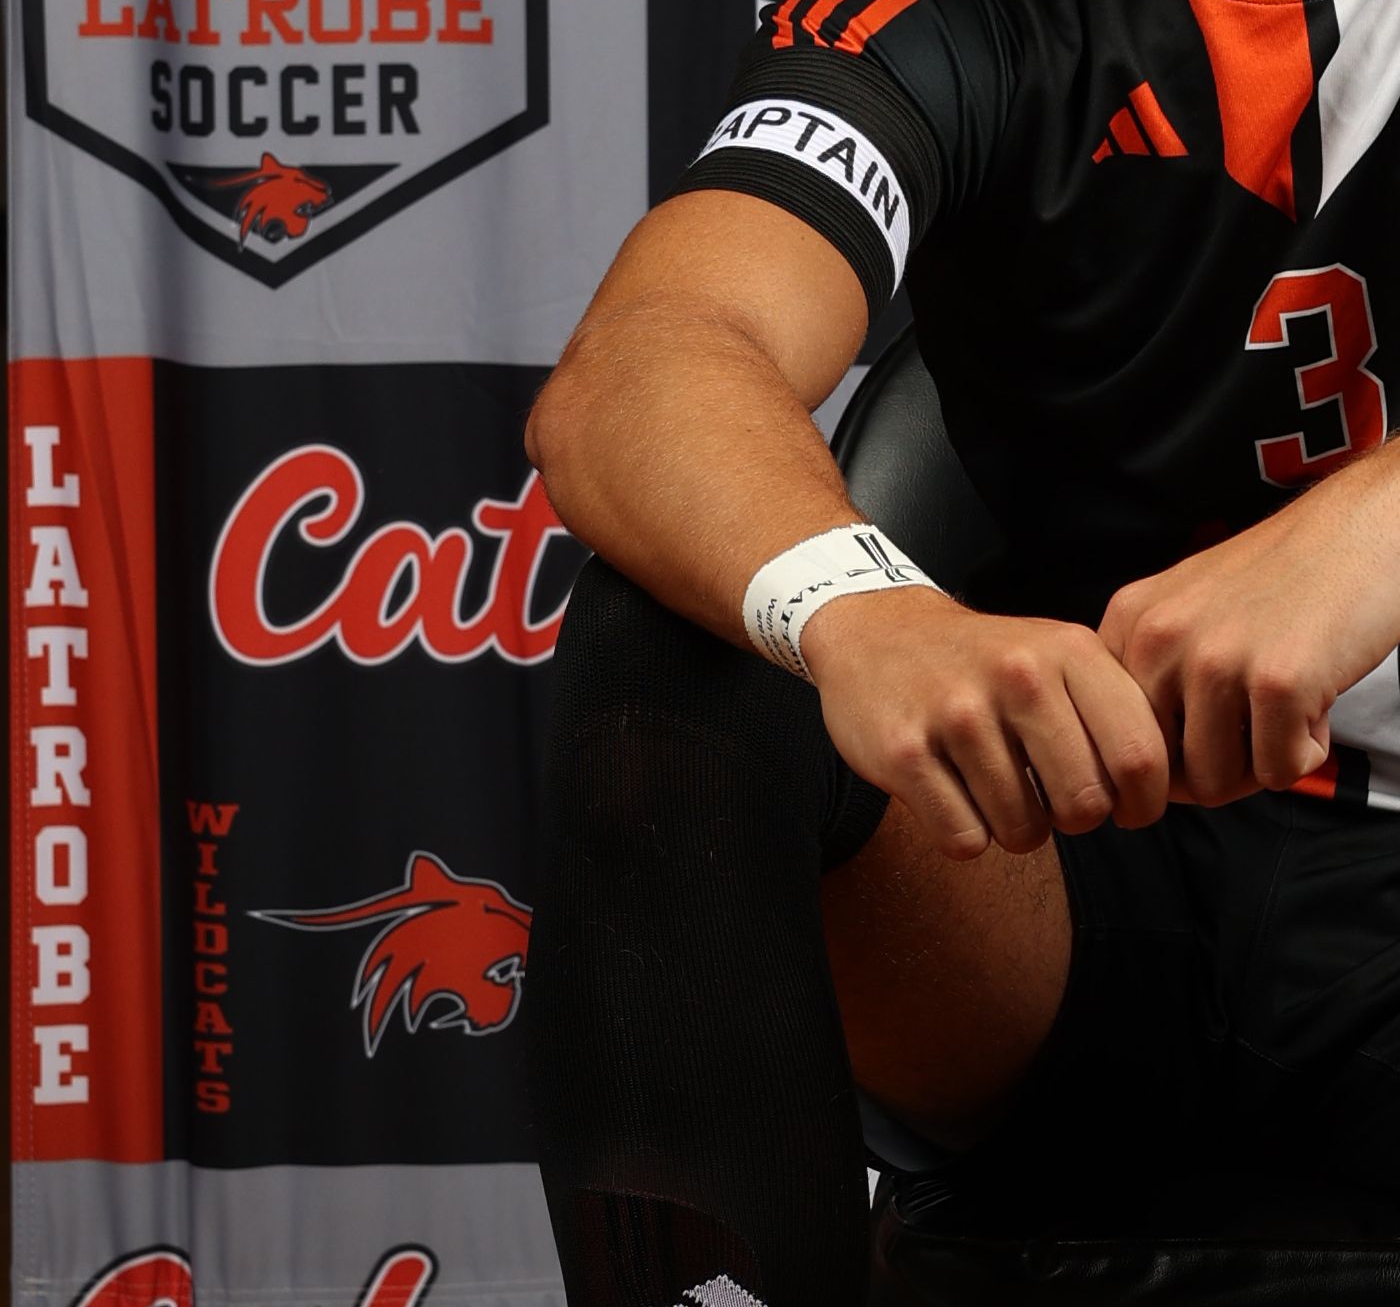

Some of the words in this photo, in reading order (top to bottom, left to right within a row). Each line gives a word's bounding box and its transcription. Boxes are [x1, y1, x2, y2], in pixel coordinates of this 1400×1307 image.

[151, 61, 421, 138] SOCCER
[703, 106, 900, 231] APTAIN
[1245, 262, 1388, 489] 3
[209, 442, 592, 667] Cat
[24, 425, 92, 1105] LATROBE
[186, 800, 242, 1114] WILDCATS
